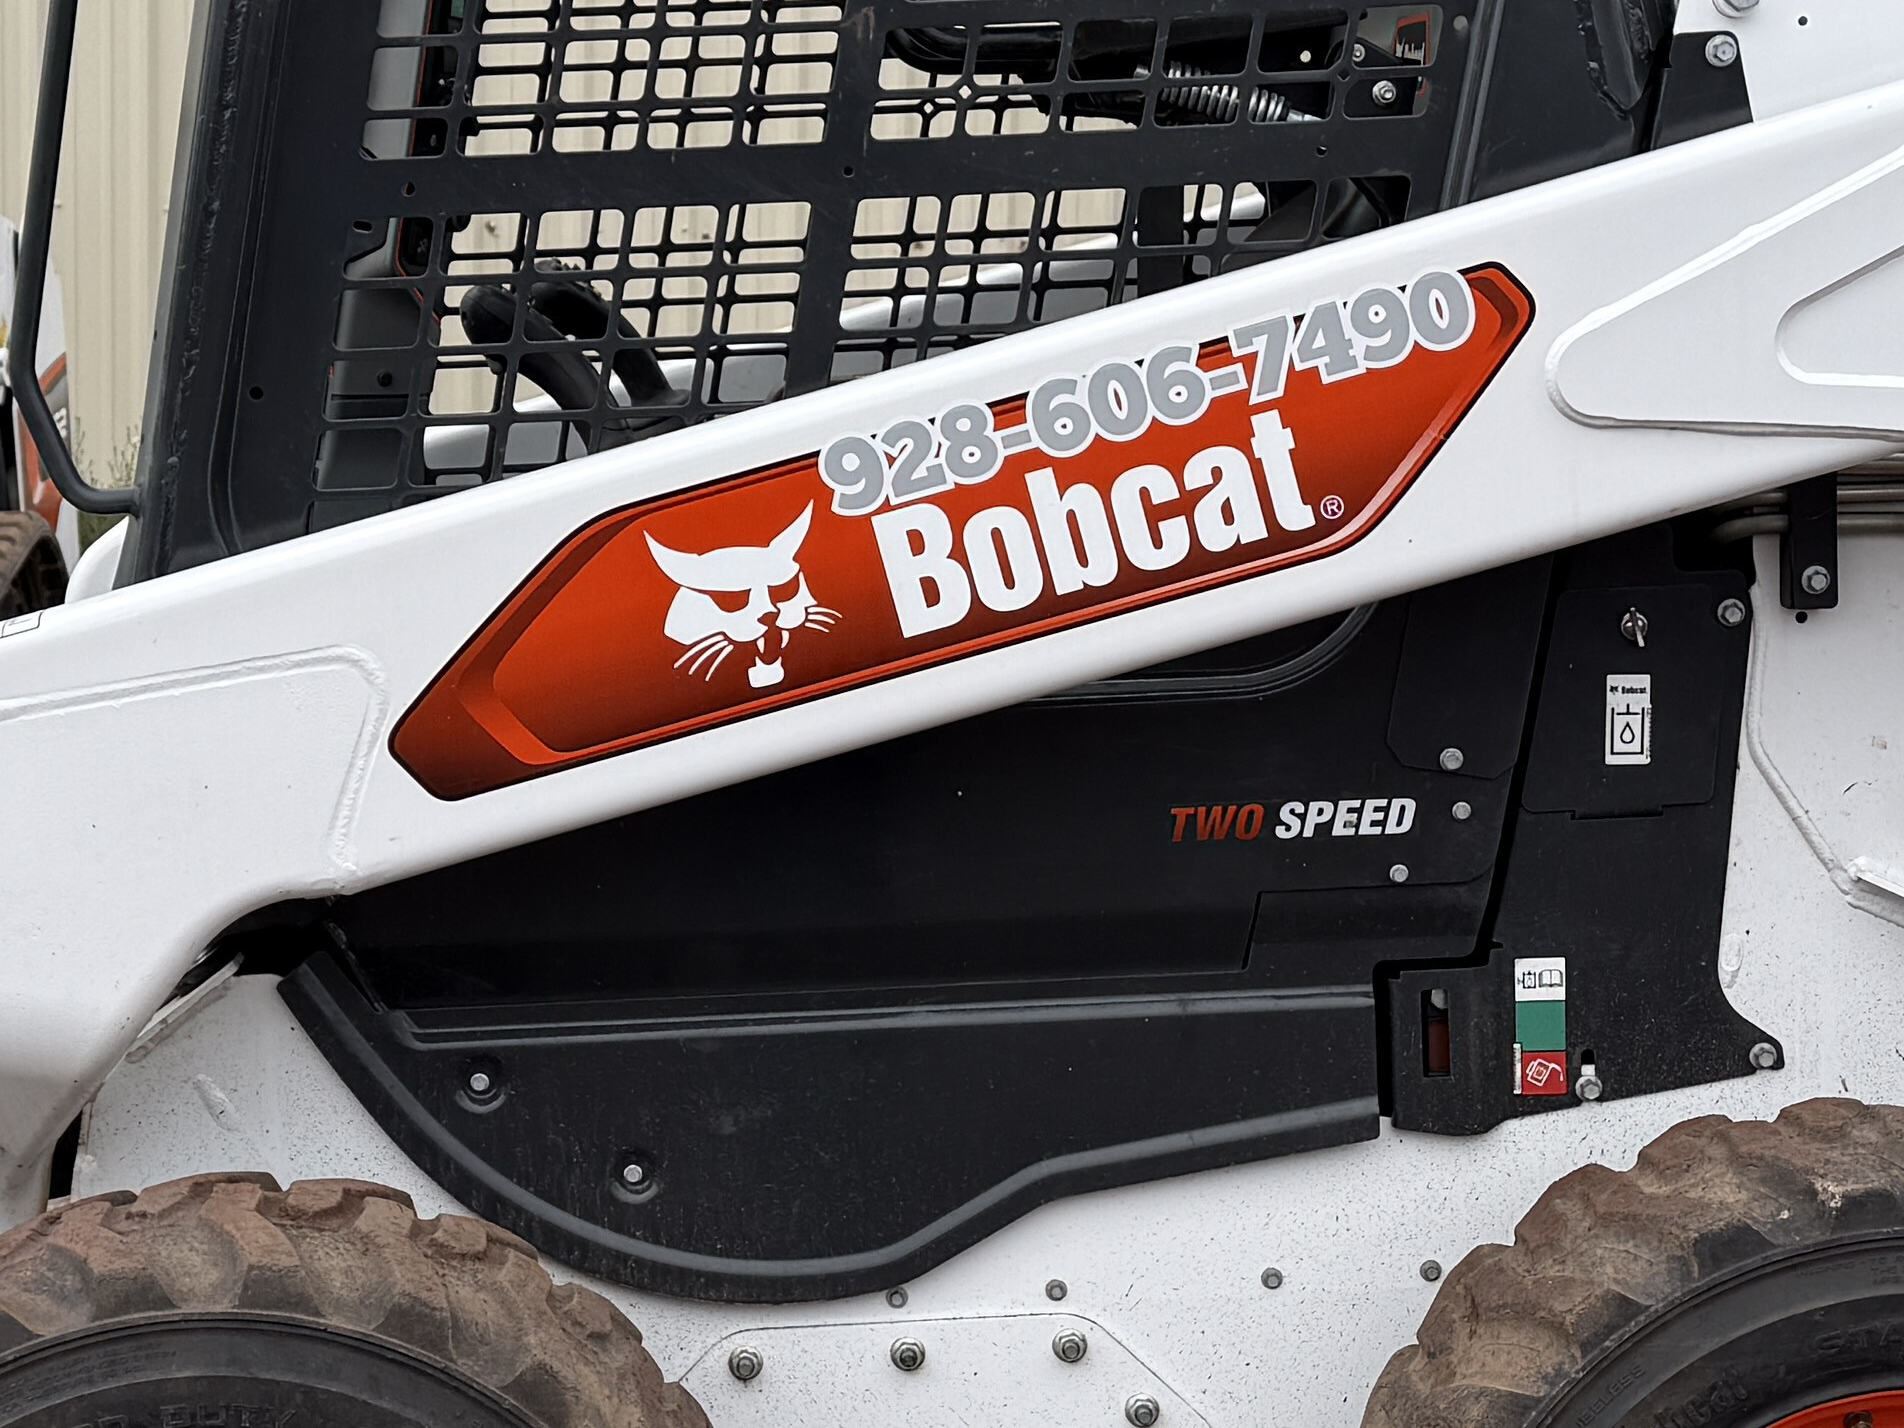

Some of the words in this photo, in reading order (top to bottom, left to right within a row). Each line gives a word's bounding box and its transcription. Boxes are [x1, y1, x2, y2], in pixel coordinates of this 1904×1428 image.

[819, 268, 1475, 514] 928-606-7490
[870, 410, 1313, 639] Bobcat
[1170, 805, 1264, 842] TWO
[1274, 798, 1417, 839] SPEED
